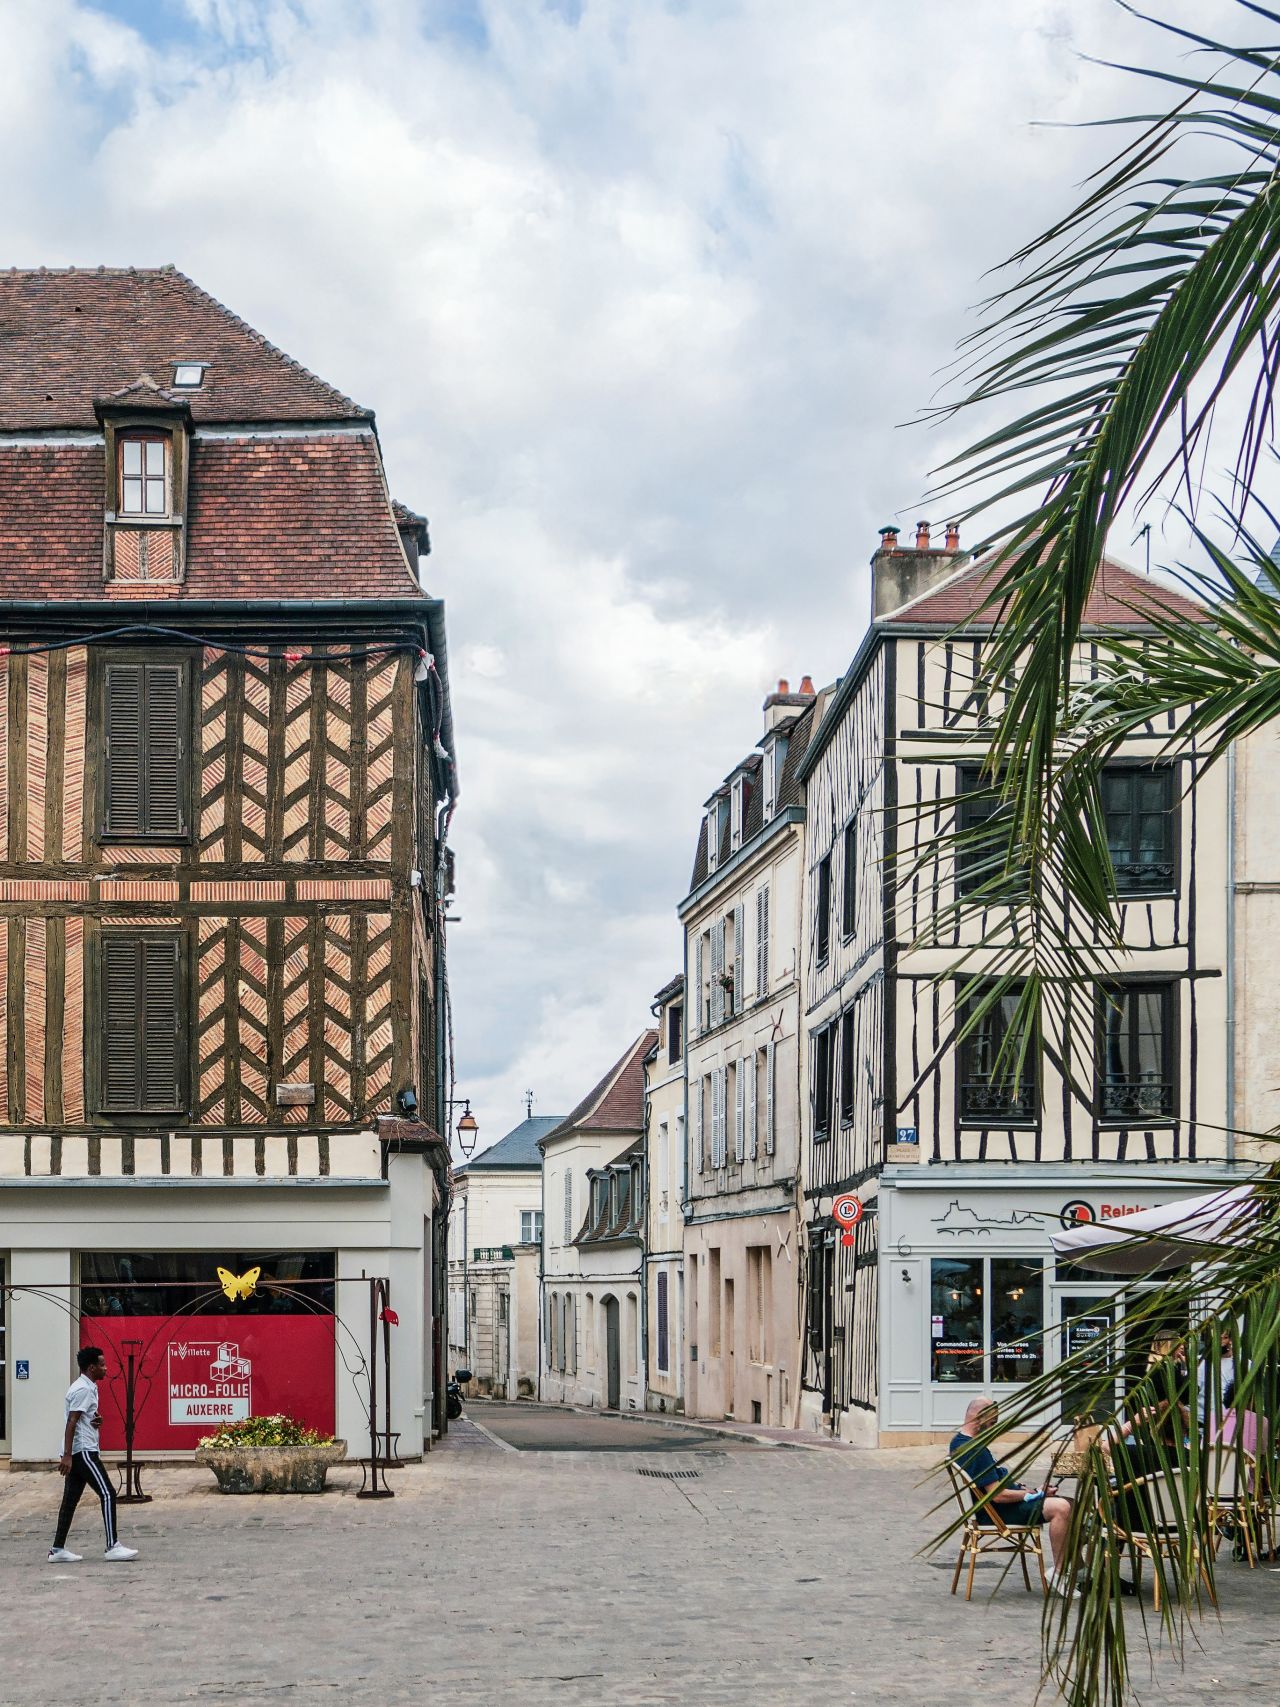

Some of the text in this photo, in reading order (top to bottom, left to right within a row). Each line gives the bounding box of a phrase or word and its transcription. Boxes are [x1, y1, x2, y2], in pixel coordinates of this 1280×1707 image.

[900, 1129, 914, 1140] 27
[171, 1342, 211, 1360] la Villette
[170, 1383, 249, 1397] MICRO-FOLIE
[186, 1403, 234, 1416] AUXERRE
